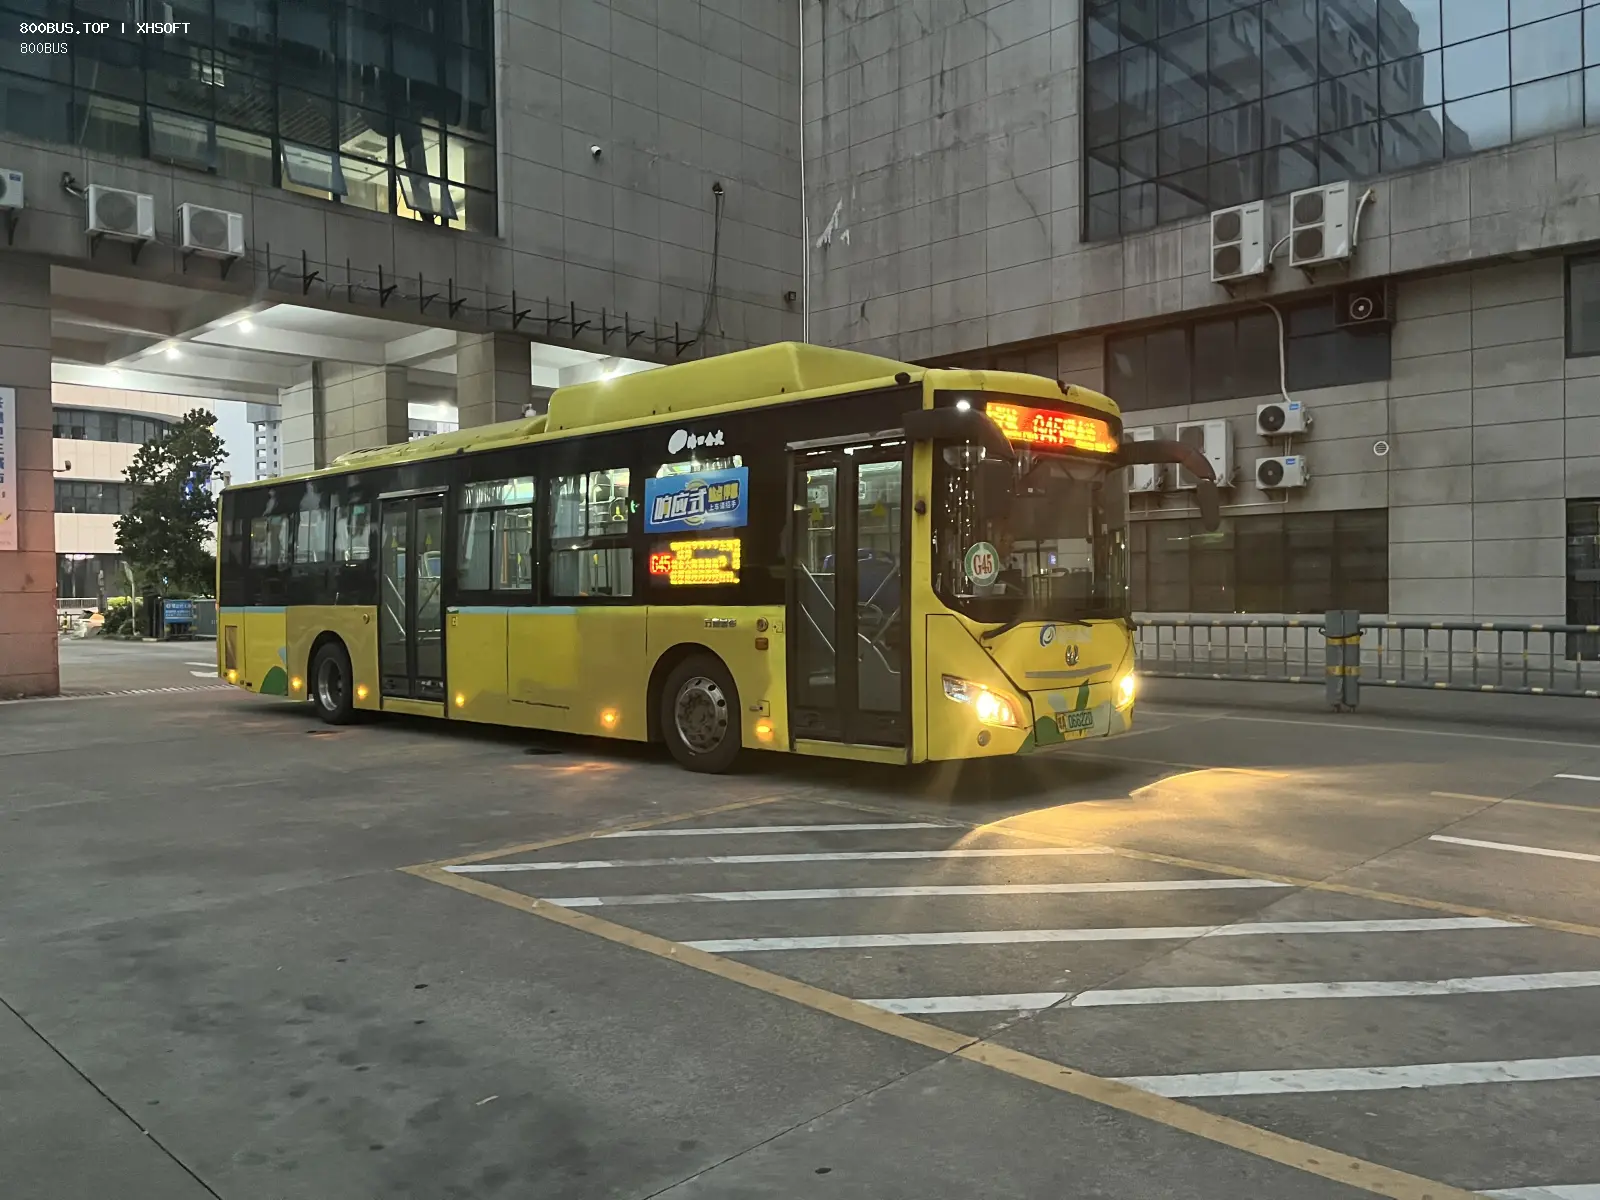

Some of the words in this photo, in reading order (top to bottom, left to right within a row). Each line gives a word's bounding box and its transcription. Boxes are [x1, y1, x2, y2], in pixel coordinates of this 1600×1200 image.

[653, 487, 708, 521] 响应式
[651, 555, 671, 573] G45
[973, 553, 993, 575] G45
